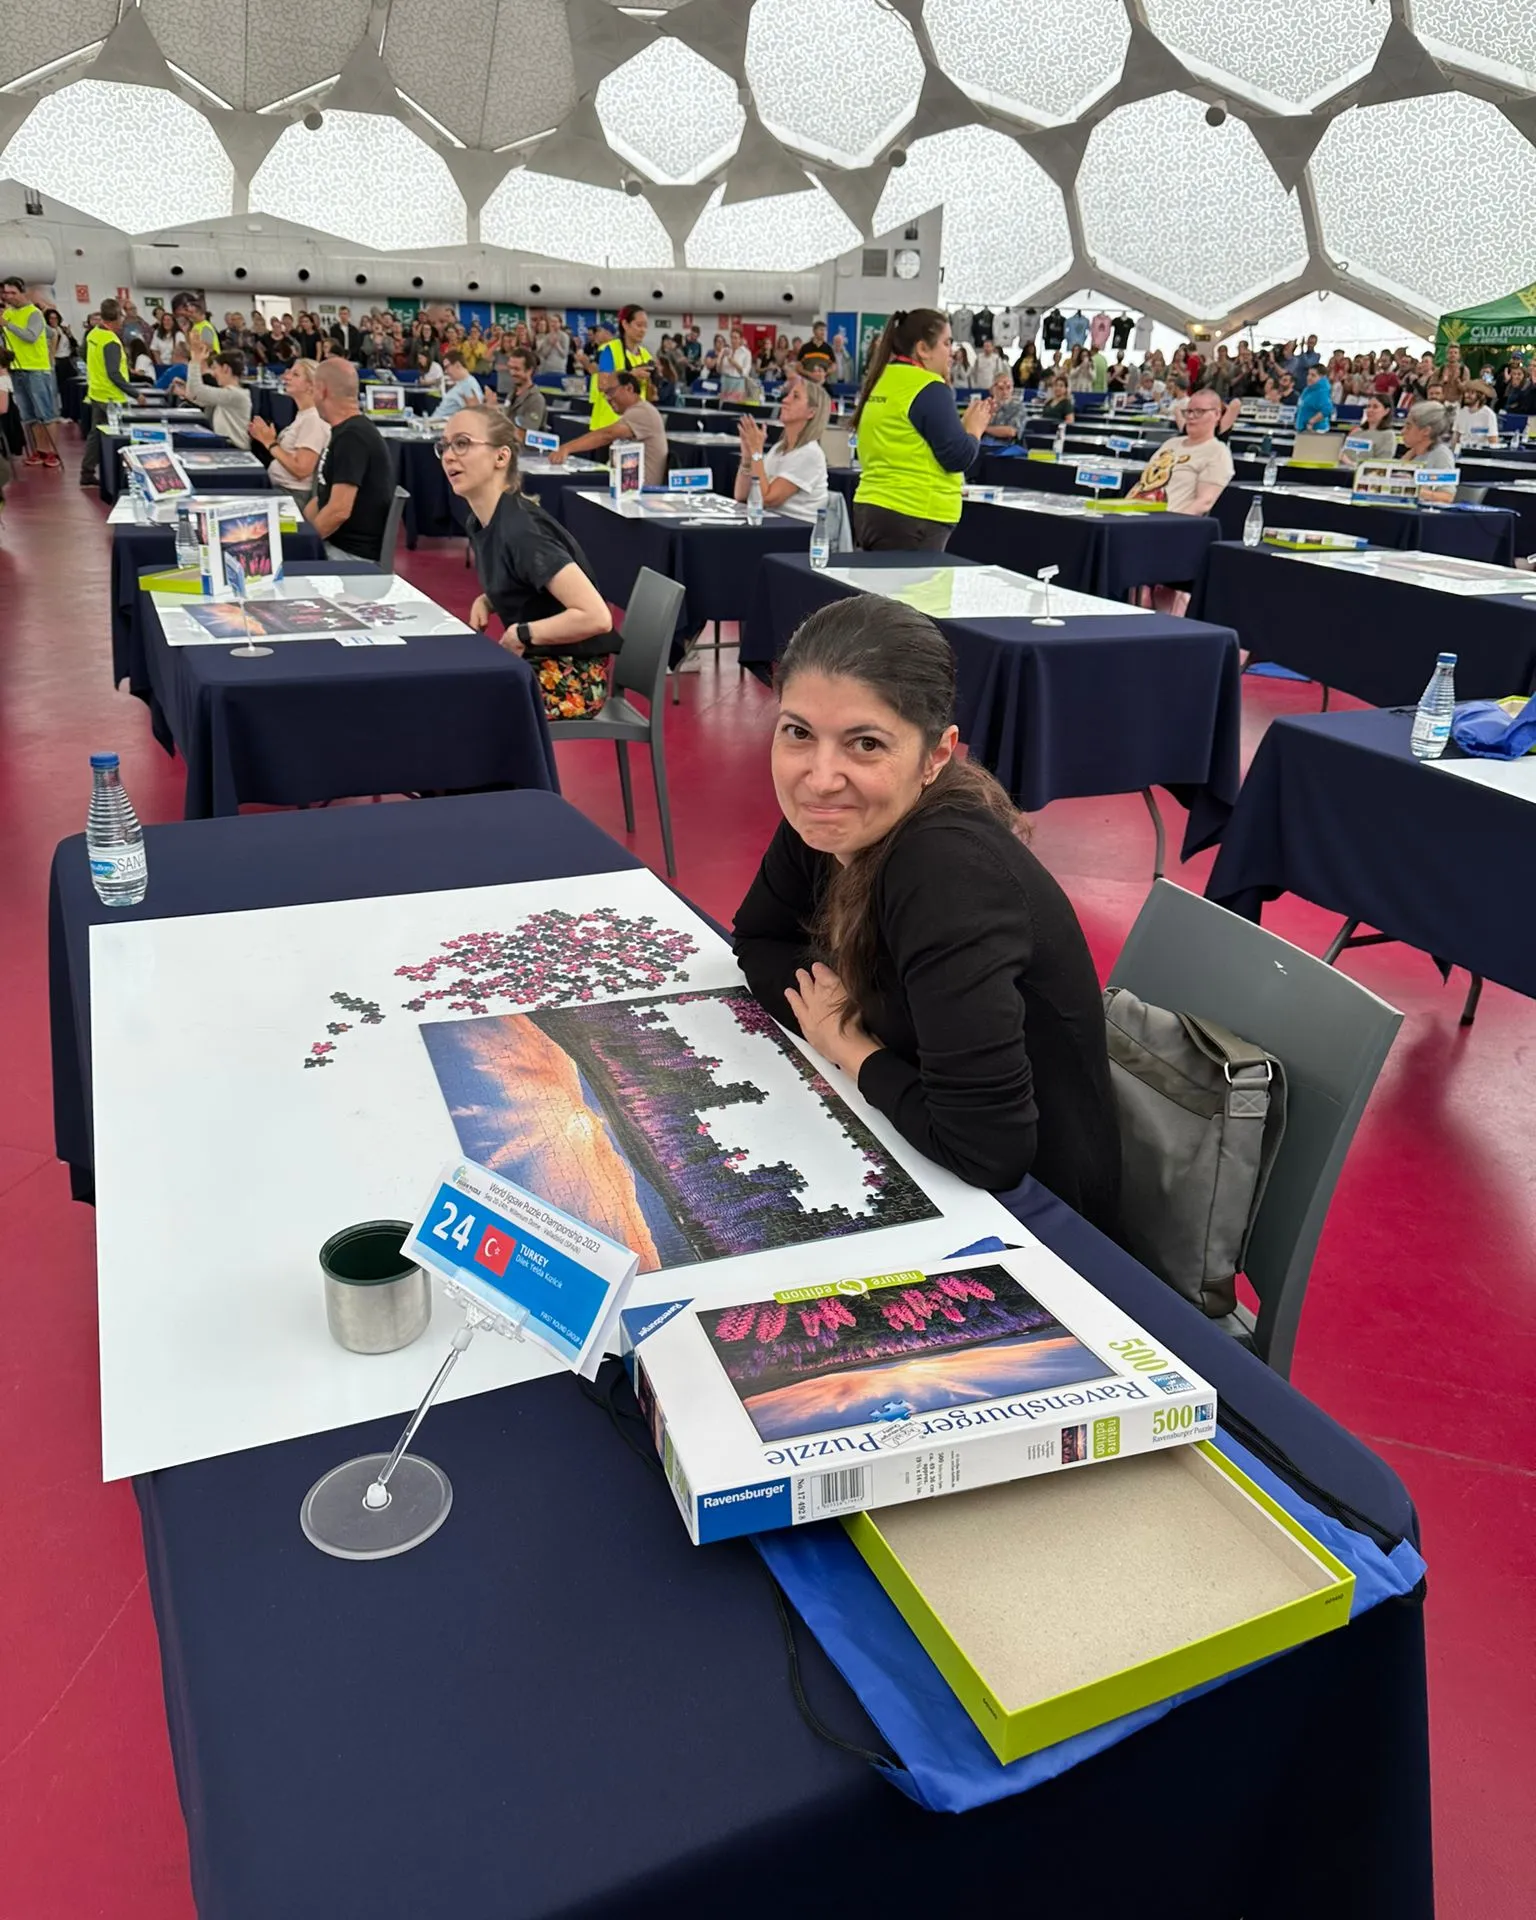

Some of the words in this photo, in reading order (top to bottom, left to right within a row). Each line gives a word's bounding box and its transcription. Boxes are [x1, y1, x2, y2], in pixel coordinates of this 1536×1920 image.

[432, 1201, 476, 1251] 24
[489, 1182, 507, 1198] World
[506, 1191, 523, 1208] Jigsaw
[523, 1202, 542, 1218] Puzzle
[541, 1213, 583, 1244] Championship
[582, 1236, 601, 1253] 2023
[515, 1254, 529, 1268] Dilek
[530, 1263, 545, 1277] Yelda
[520, 1243, 549, 1267] TURKEY
[780, 1285, 833, 1300] edition
[871, 1271, 917, 1286] nature
[638, 1303, 683, 1336] Ravensburger
[1108, 1338, 1169, 1371] 500
[921, 1381, 1150, 1435] Ravensburger
[1152, 1404, 1193, 1435] 500
[764, 1432, 881, 1466] Puzzle
[1096, 1422, 1106, 1456] edition
[1107, 1420, 1117, 1453] nature
[1152, 1428, 1194, 1443] Ravensburger
[1194, 1424, 1213, 1437] Puzzle
[703, 1483, 785, 1509] Ravensburger
